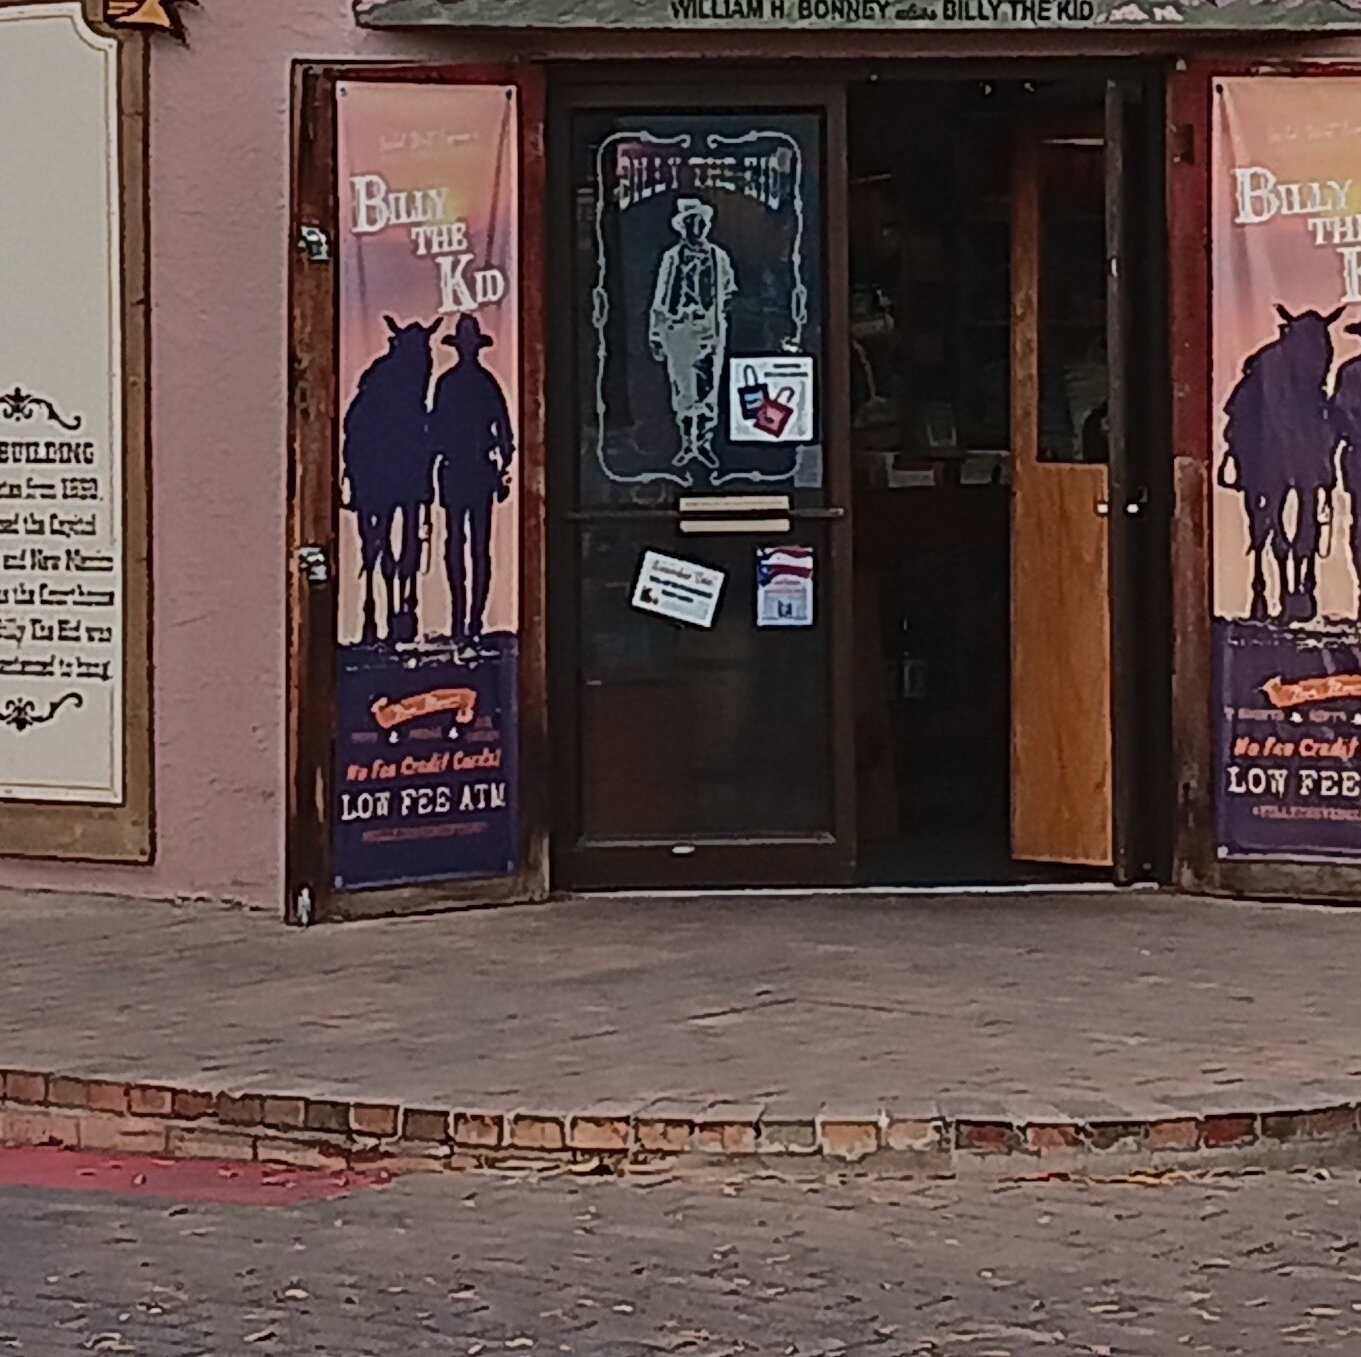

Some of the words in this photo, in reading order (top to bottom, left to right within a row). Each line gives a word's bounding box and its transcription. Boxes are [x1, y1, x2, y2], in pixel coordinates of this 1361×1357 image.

[942, 0, 1002, 21] BILLY
[1004, 0, 1052, 24] THE
[1057, 0, 1094, 21] KID
[411, 222, 468, 255] THE
[1298, 736, 1360, 759] Credit
[1298, 769, 1361, 798] FEE
[401, 787, 451, 817] FEE
